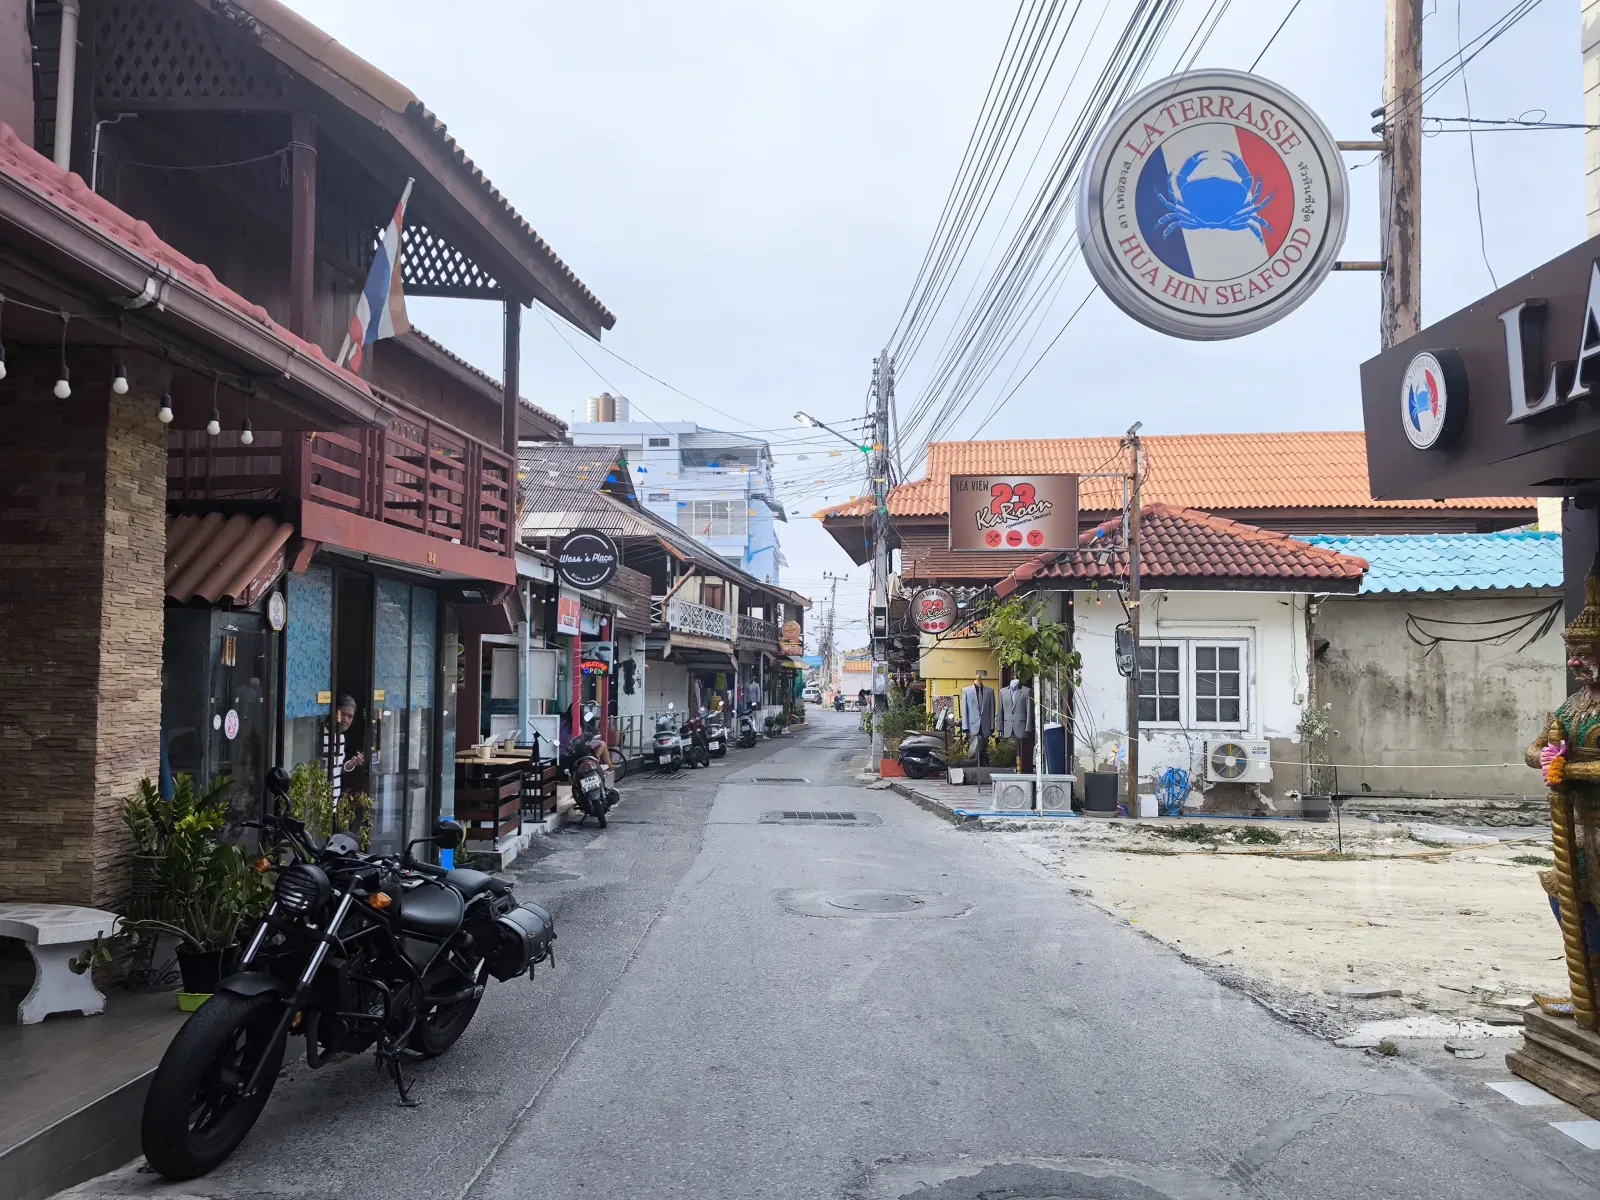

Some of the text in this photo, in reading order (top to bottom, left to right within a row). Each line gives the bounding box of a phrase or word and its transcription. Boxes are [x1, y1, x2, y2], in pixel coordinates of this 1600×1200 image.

[1125, 95, 1303, 161] LA TERRASSE
[1118, 227, 1312, 306] HUA HIN SEAFOOD
[955, 480, 990, 492] SEA VIEW
[990, 482, 1036, 516] 23
[975, 498, 1053, 531] KaRoon
[559, 553, 583, 563] Wass
[591, 552, 614, 563] Place
[922, 598, 944, 616] 23
[580, 661, 608, 671] WELCOME
[583, 667, 603, 676] OPEN
